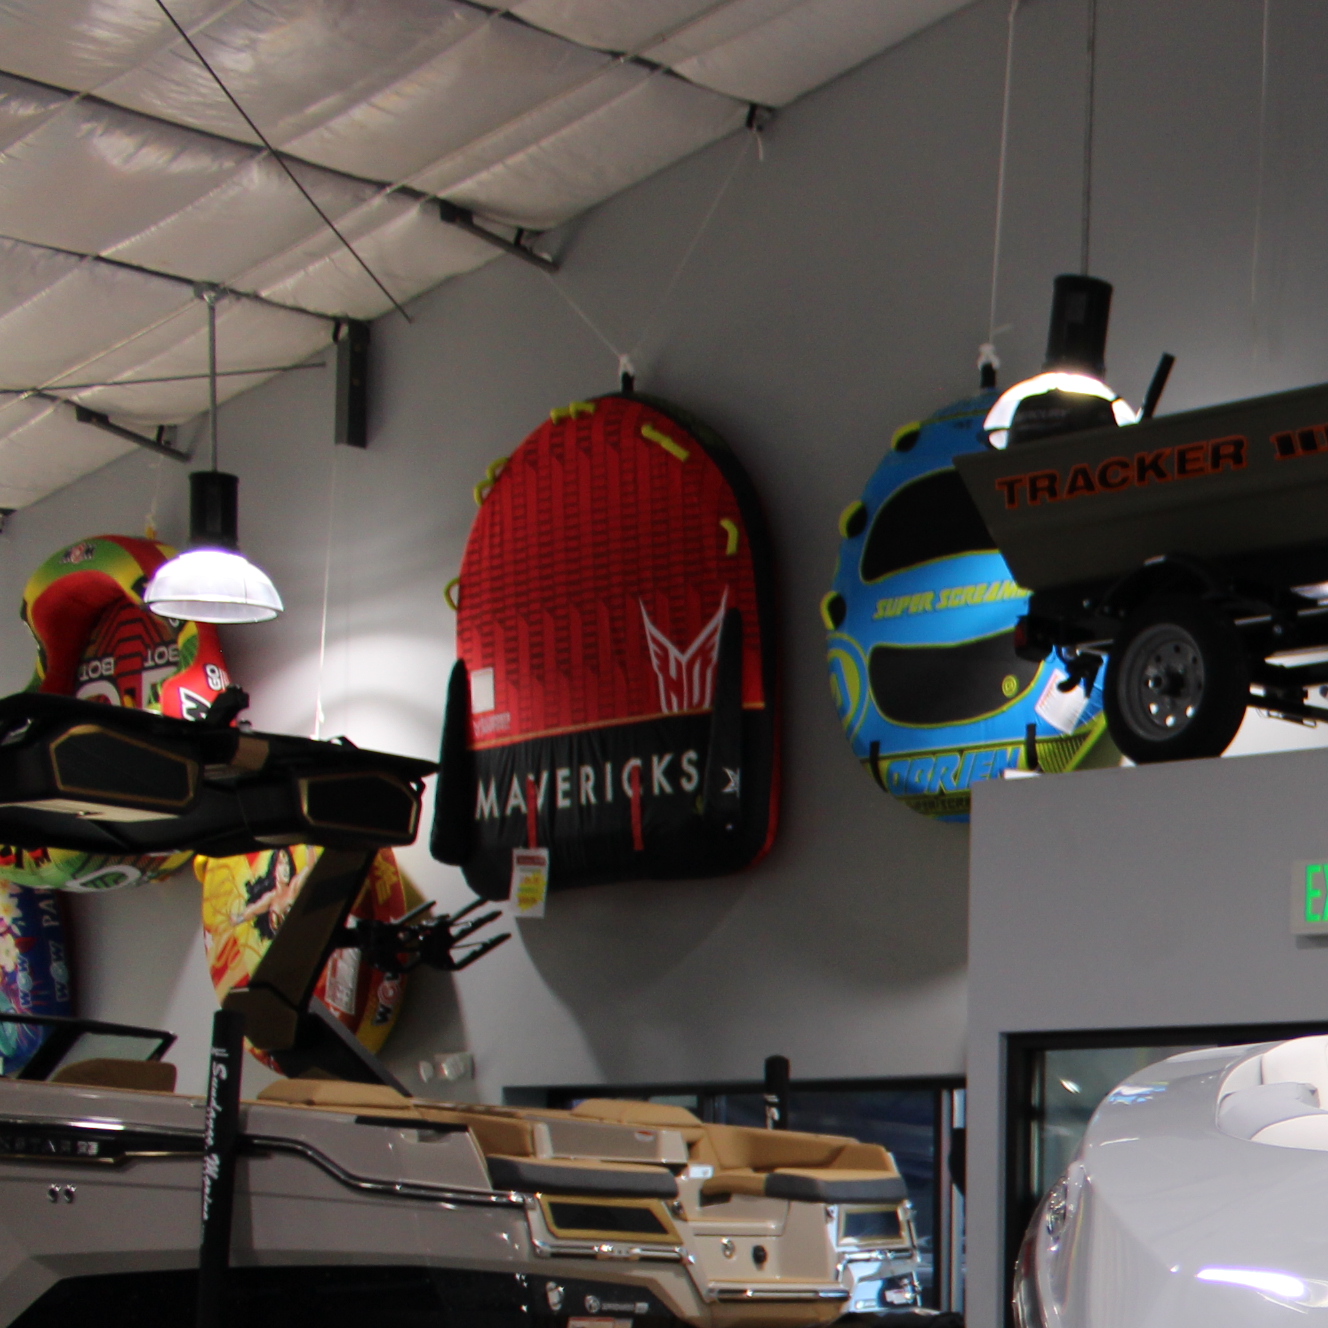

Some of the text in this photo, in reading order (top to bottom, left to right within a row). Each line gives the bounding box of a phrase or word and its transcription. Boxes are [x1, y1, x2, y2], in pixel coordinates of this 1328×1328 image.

[995, 434, 1248, 510] TRACKER
[873, 592, 935, 620] SUPER
[78, 656, 115, 681] BOT
[474, 749, 701, 821] MAVERICKS
